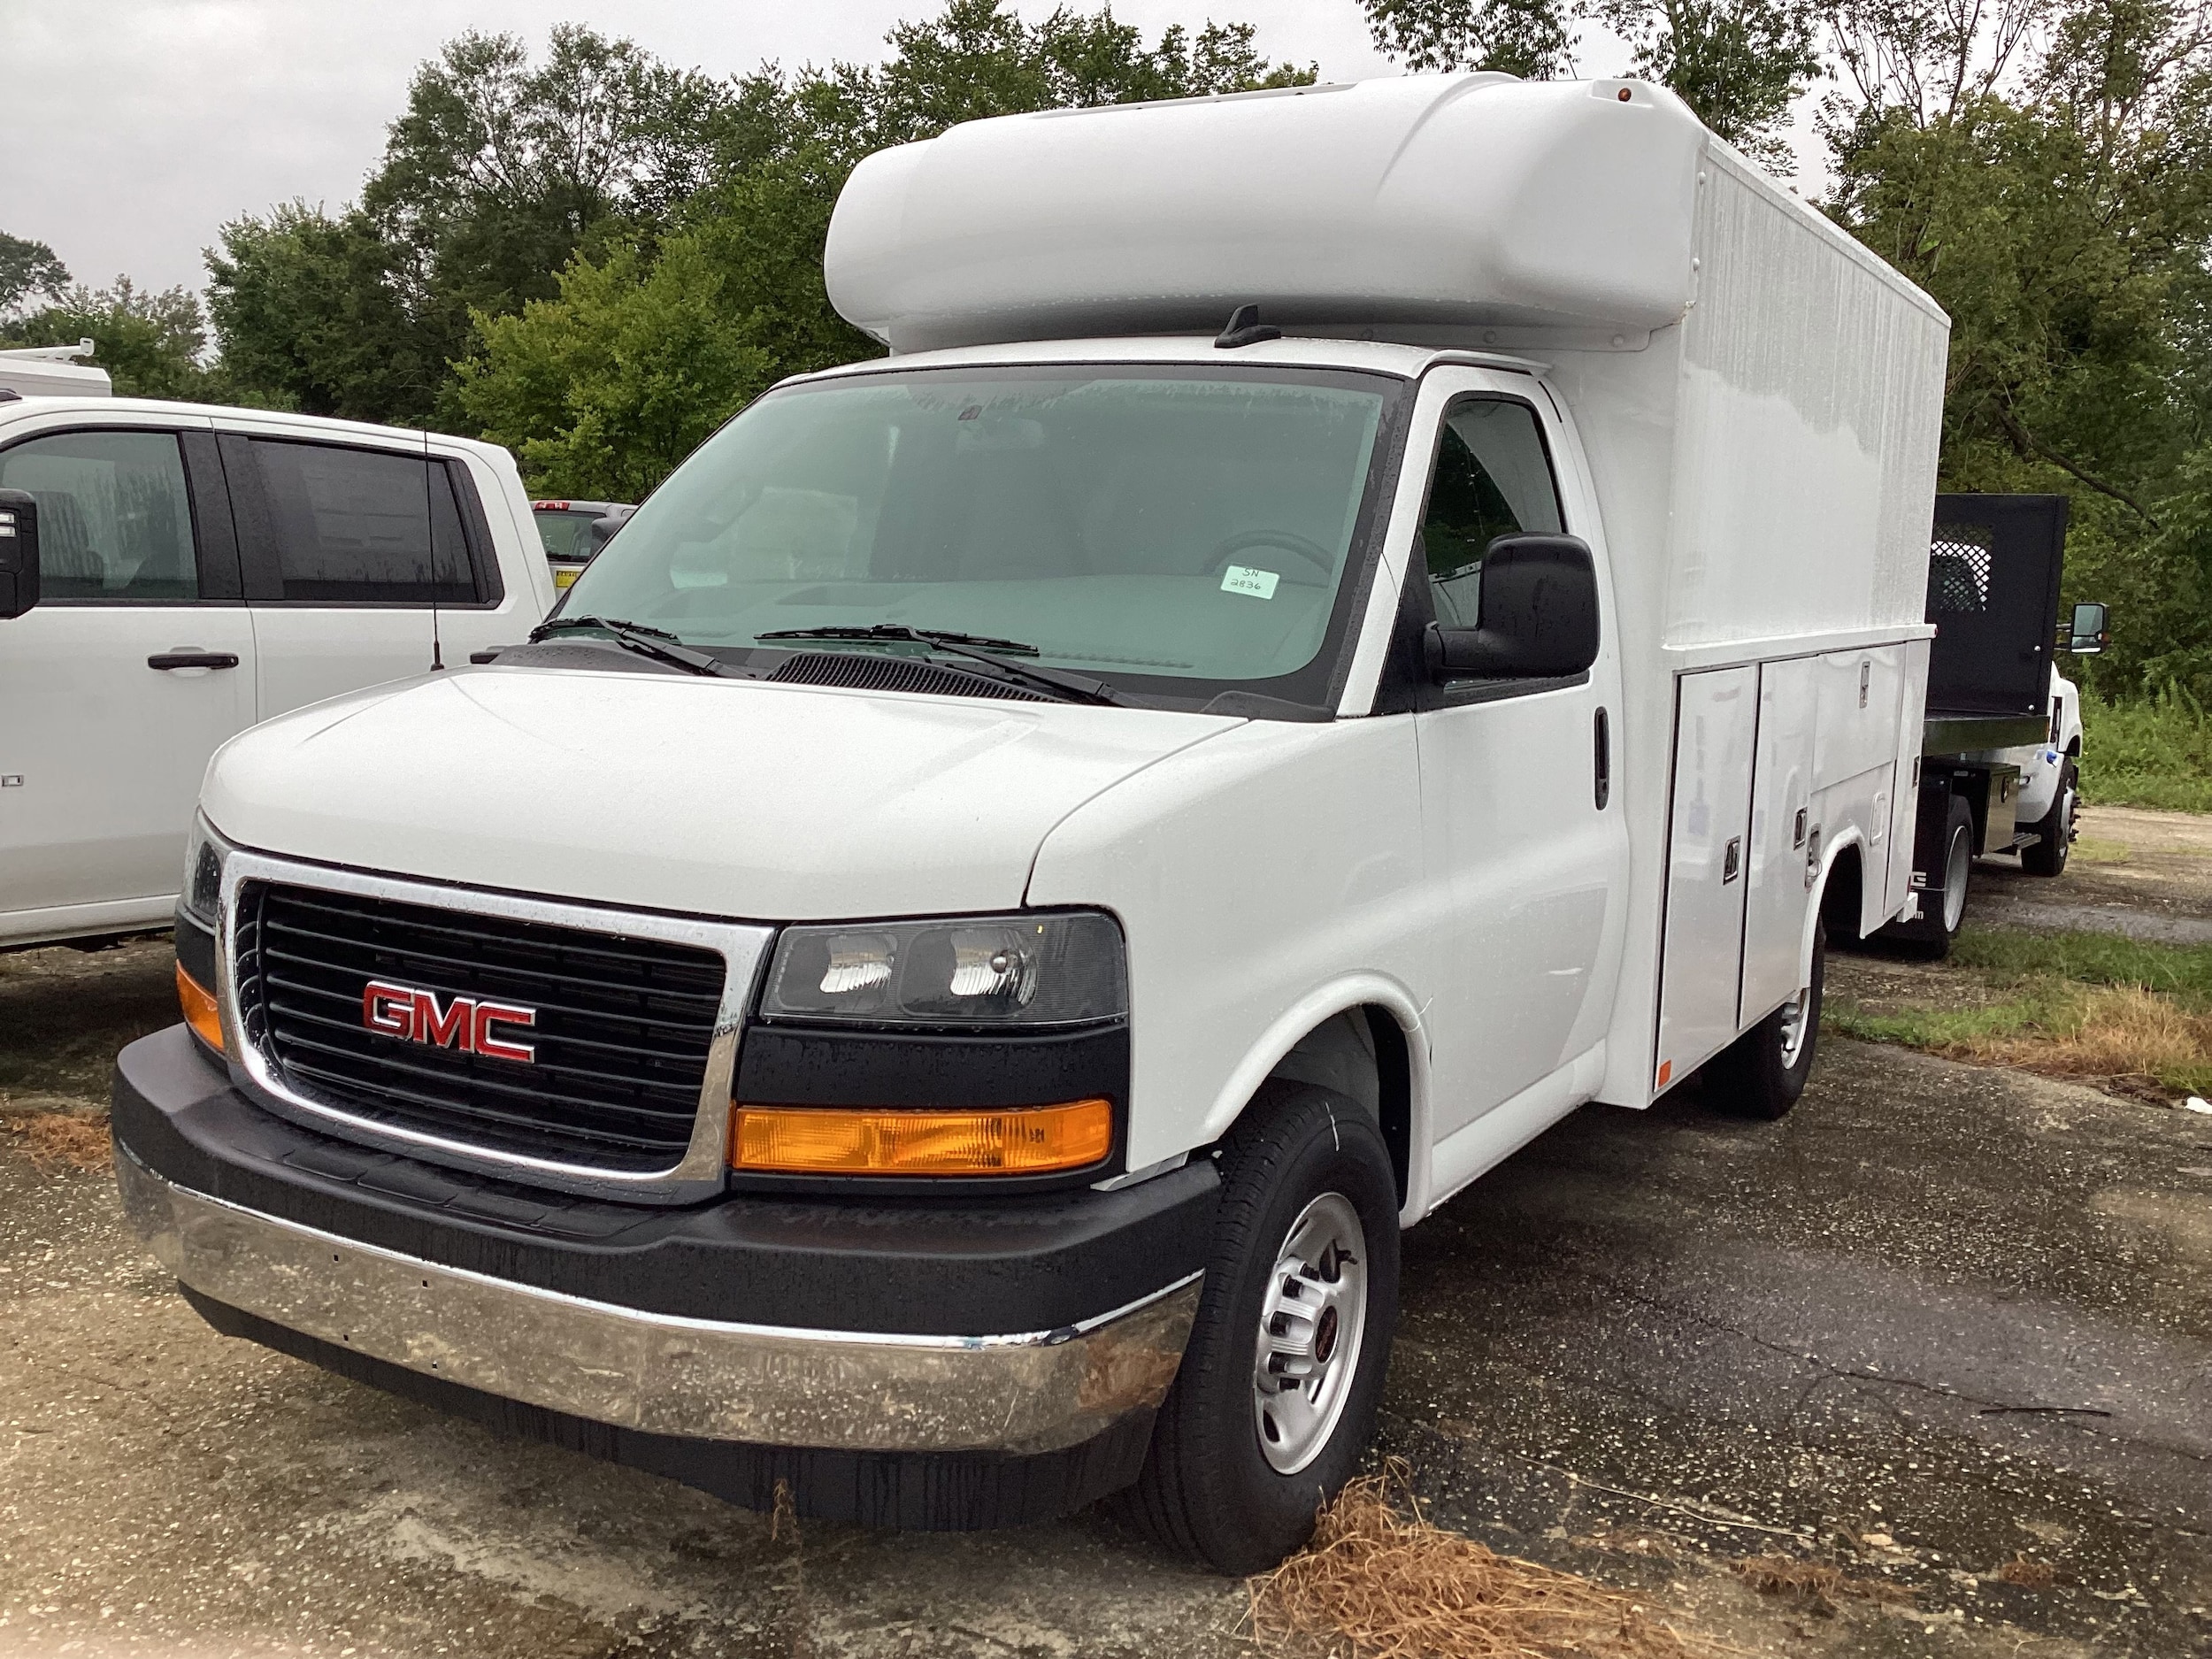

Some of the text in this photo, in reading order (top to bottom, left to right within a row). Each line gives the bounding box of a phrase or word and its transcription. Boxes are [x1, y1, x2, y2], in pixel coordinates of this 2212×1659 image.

[1242, 567, 1260, 577] SN
[1230, 579, 1261, 590] 2836
[363, 980, 536, 1064] GMC
